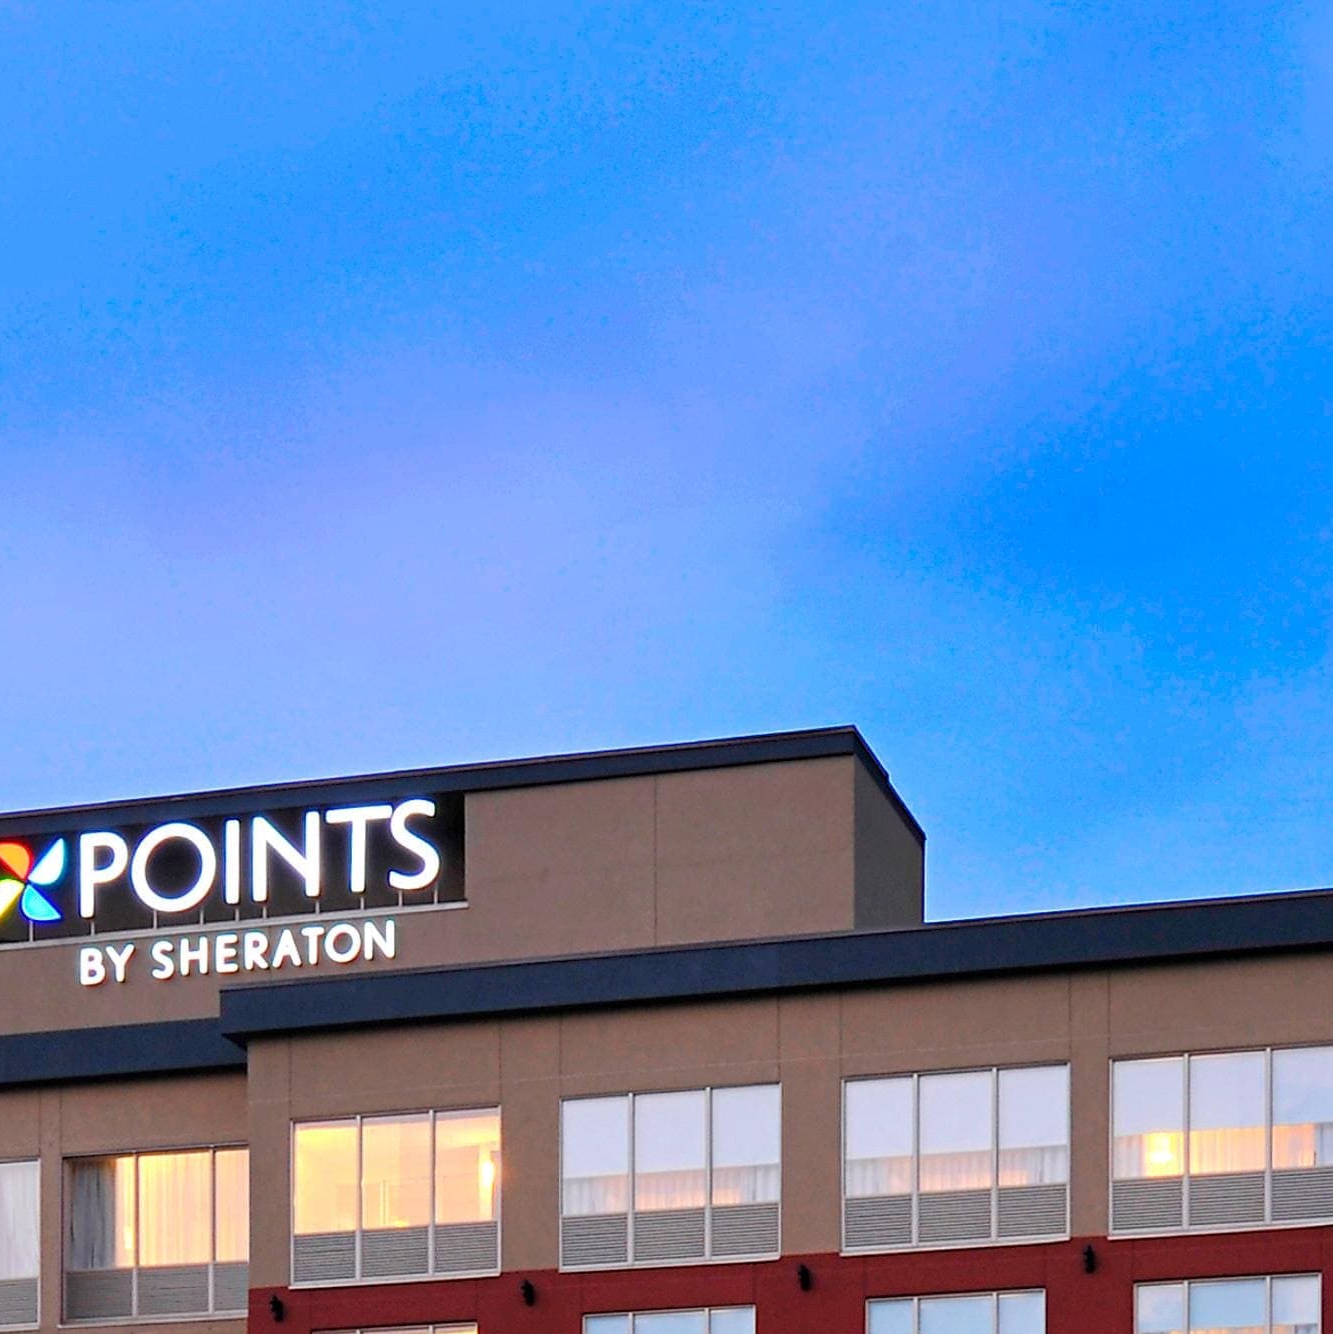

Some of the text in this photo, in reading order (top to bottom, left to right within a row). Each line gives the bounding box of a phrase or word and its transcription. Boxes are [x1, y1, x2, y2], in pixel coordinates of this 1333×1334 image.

[79, 799, 440, 919] POINTS
[79, 920, 395, 986] BY SHERATON
